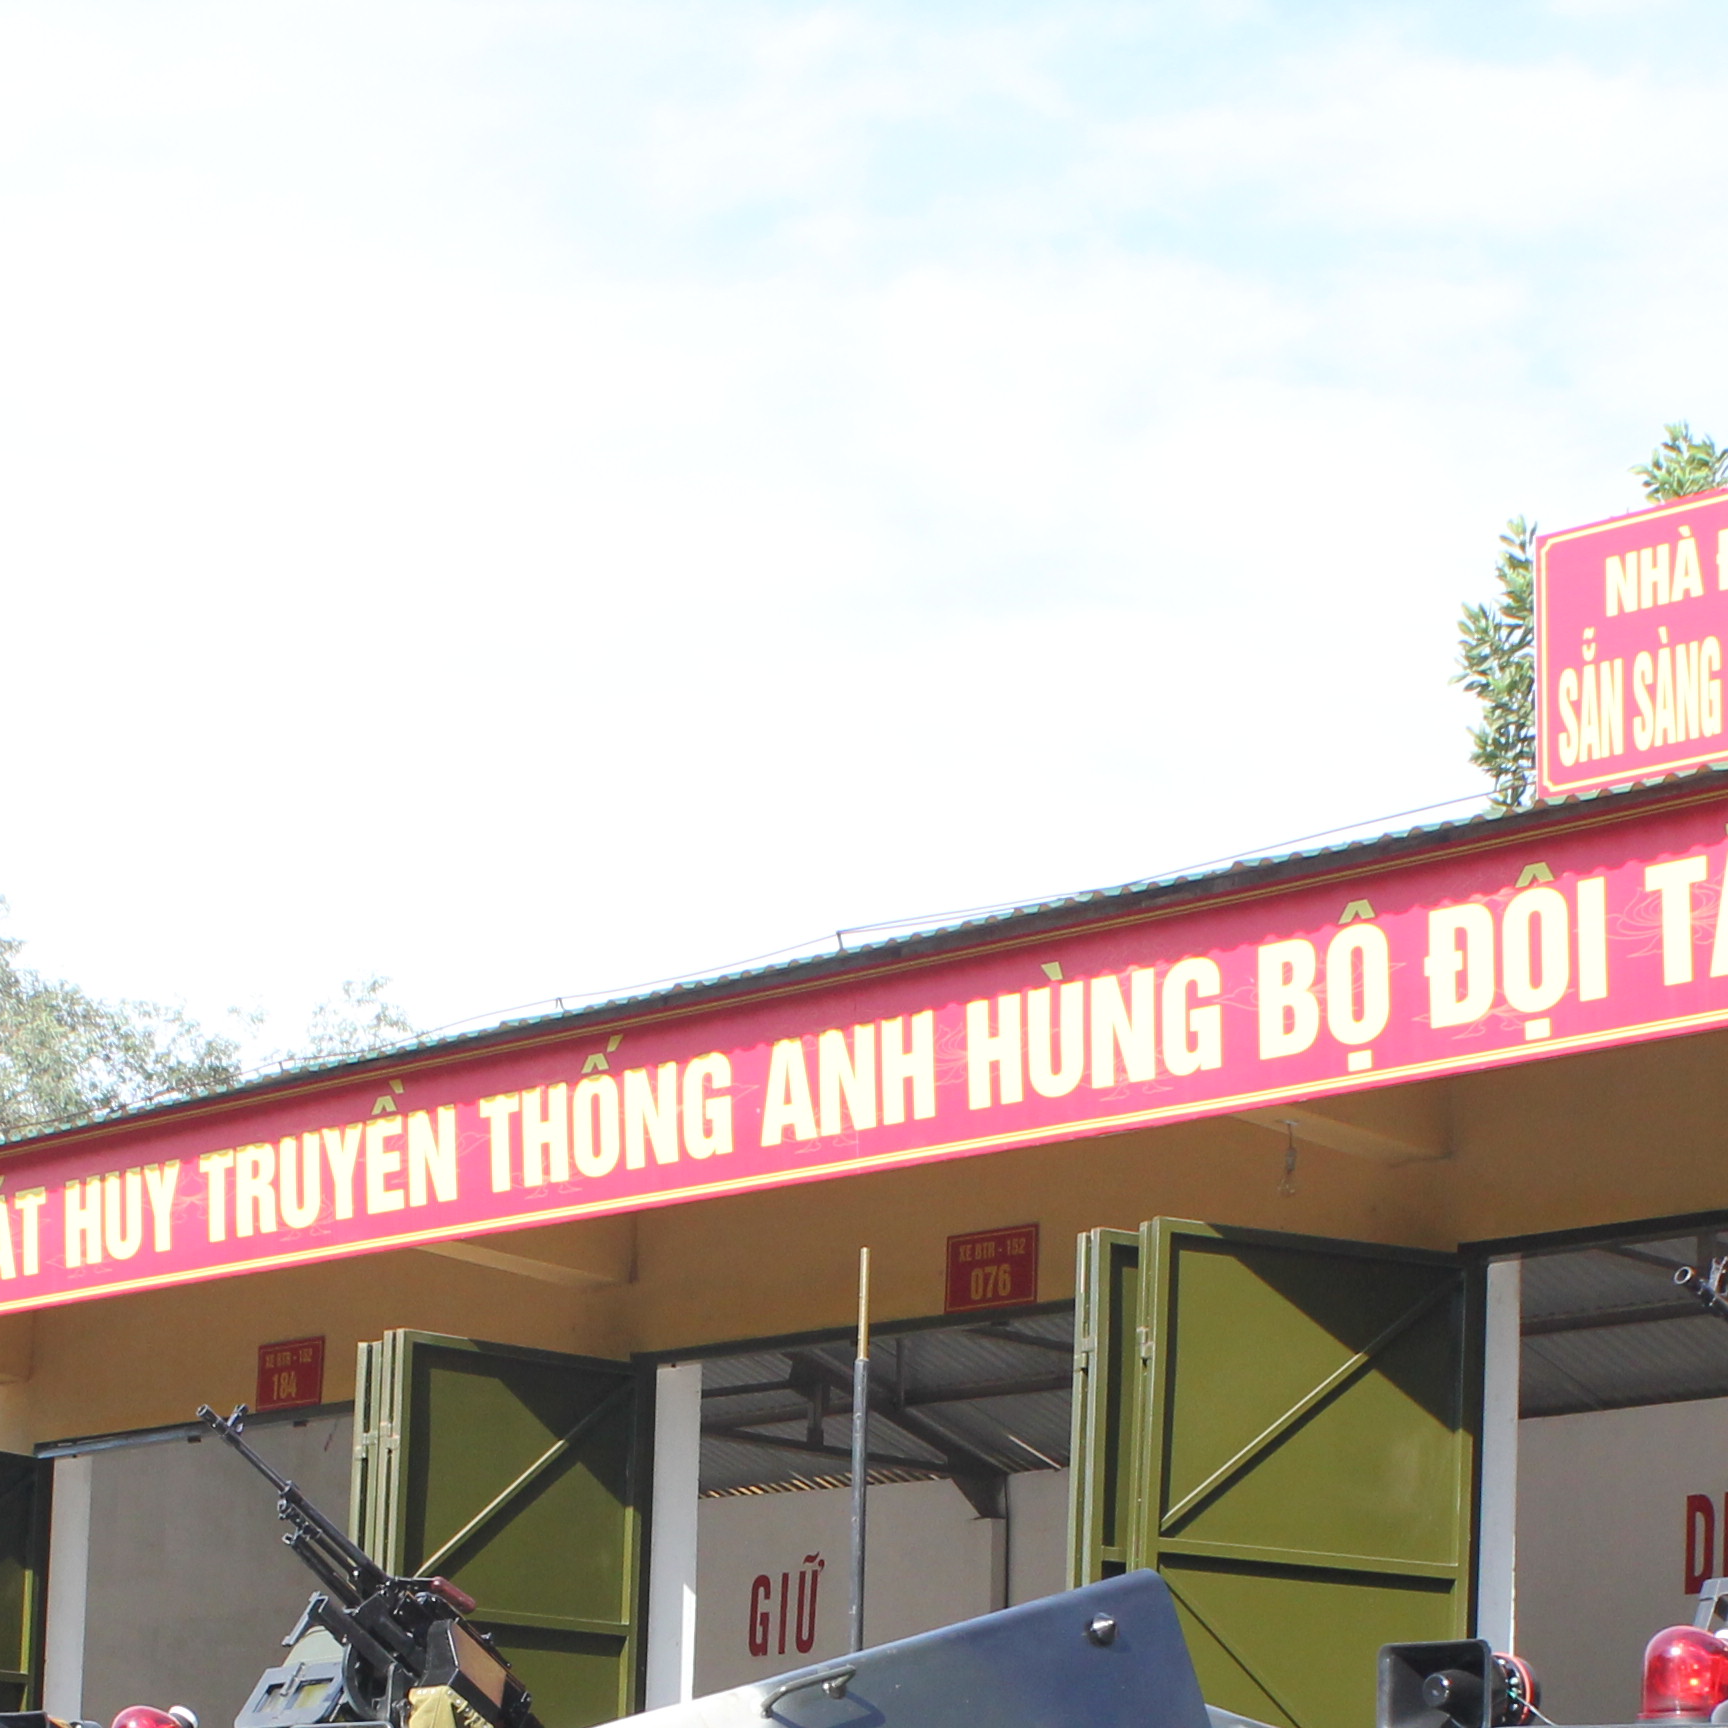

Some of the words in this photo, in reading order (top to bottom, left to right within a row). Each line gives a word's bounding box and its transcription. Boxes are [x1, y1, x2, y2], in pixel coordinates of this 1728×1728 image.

[1606, 525, 1704, 617] NHÀ
[1558, 627, 1624, 768] SẴN
[1632, 626, 1722, 752] SÀNG
[64, 1160, 181, 1266] HUY
[200, 1078, 458, 1242] TRUYỀN
[480, 1035, 732, 1178] THỐNG
[760, 1013, 936, 1148] ANH
[966, 960, 1223, 1106] HÙNG
[1257, 899, 1389, 1072] BỘ
[1424, 862, 1607, 1040] ĐỘI
[970, 1263, 1011, 1300] 076
[272, 1371, 297, 1400] 184
[747, 1551, 825, 1657] GIỮ
